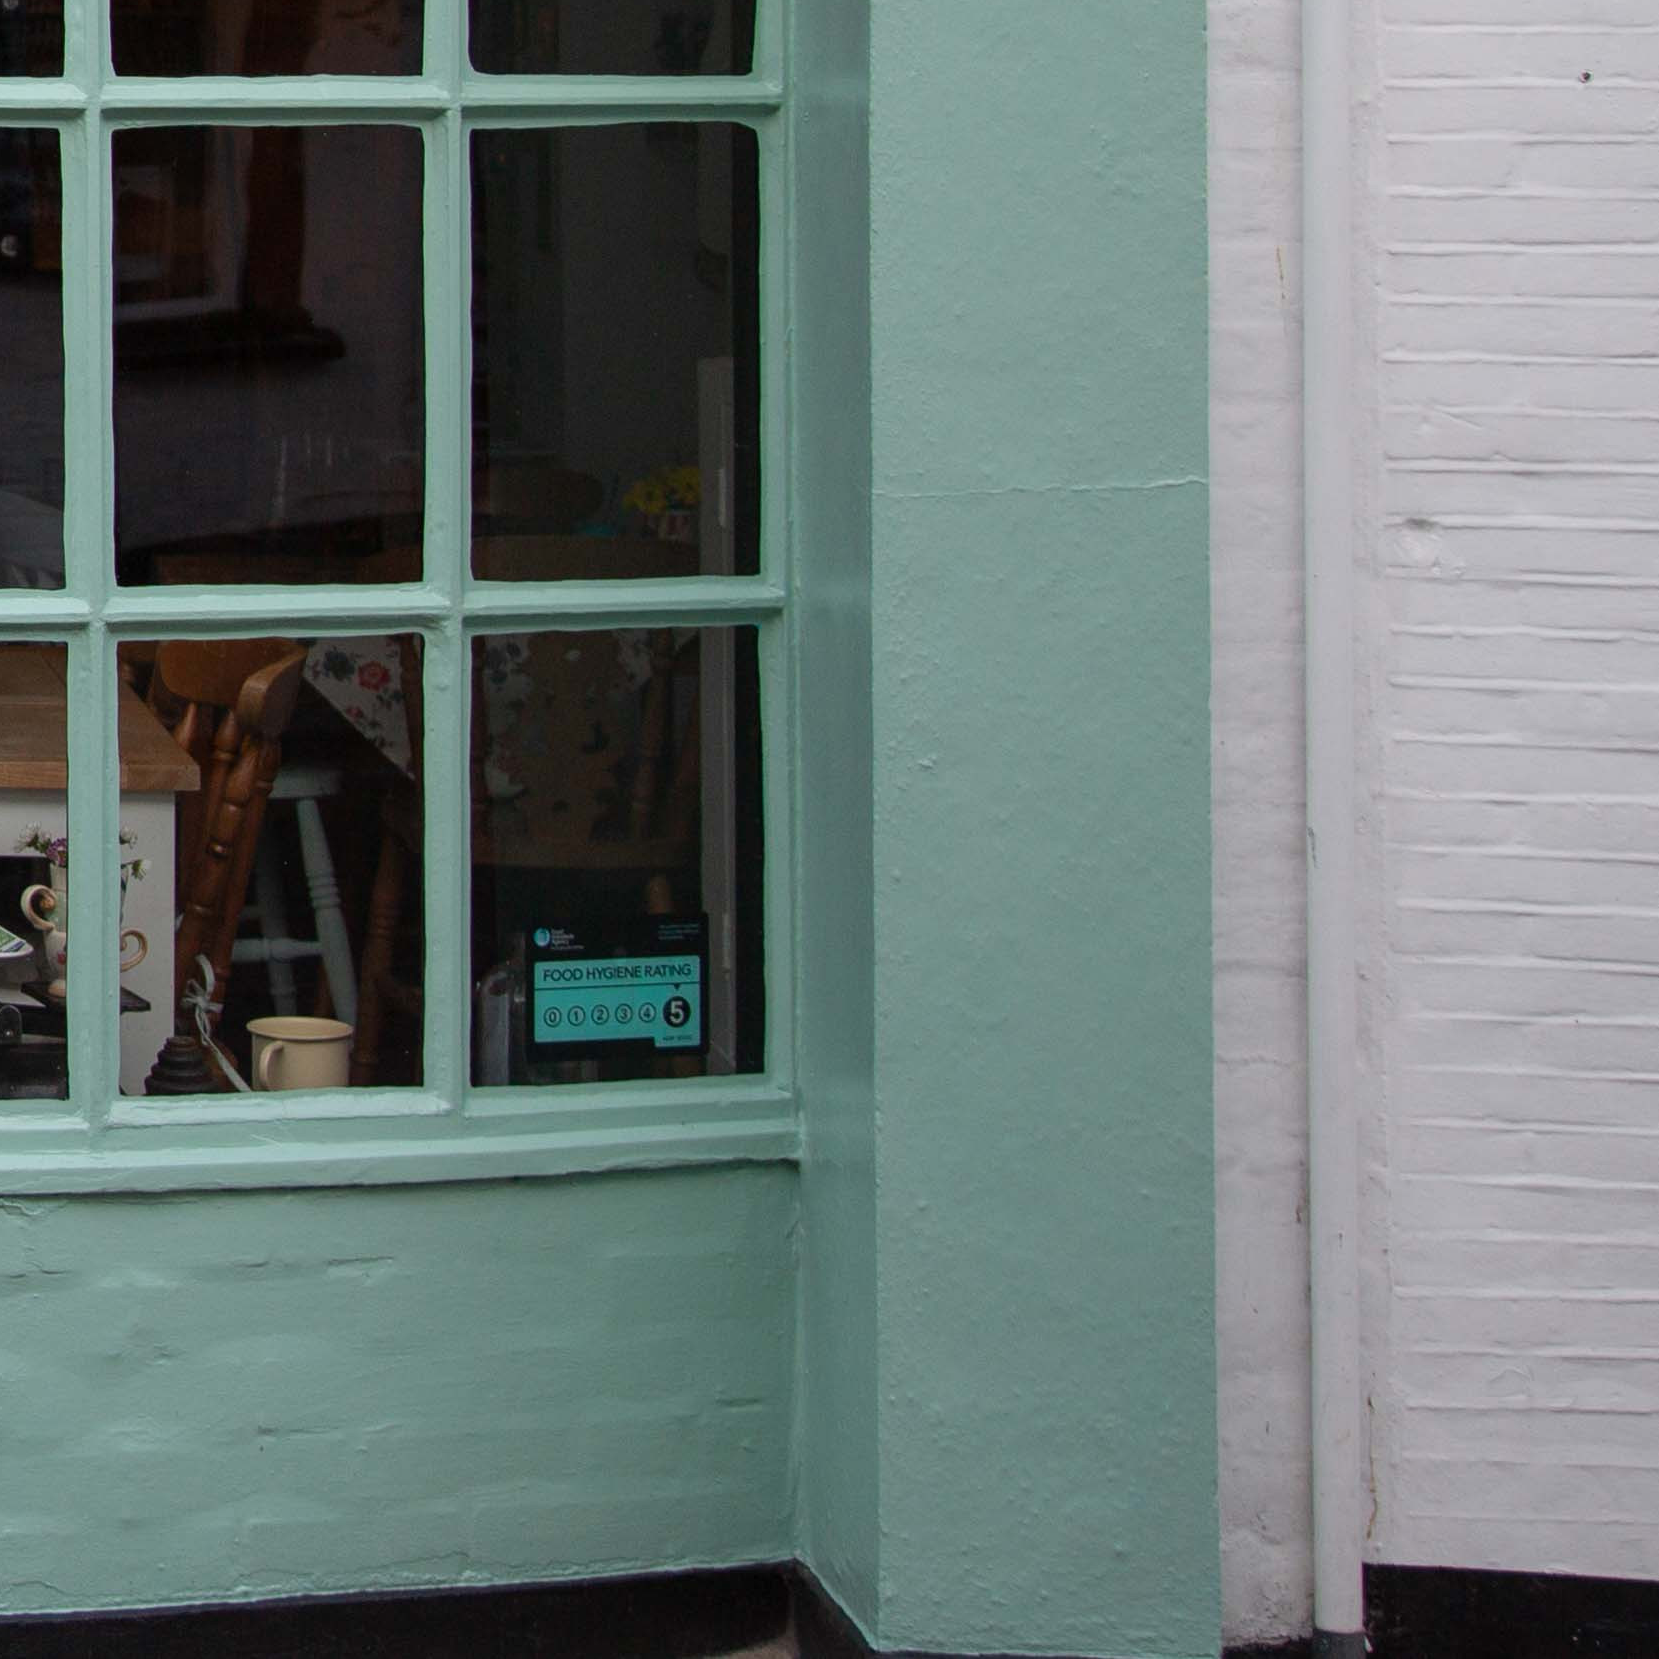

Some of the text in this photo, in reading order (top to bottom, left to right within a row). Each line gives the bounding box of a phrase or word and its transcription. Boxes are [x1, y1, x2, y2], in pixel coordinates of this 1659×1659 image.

[543, 963, 692, 982] FOOD HYGIENE RATING
[669, 1000, 685, 1025] 5
